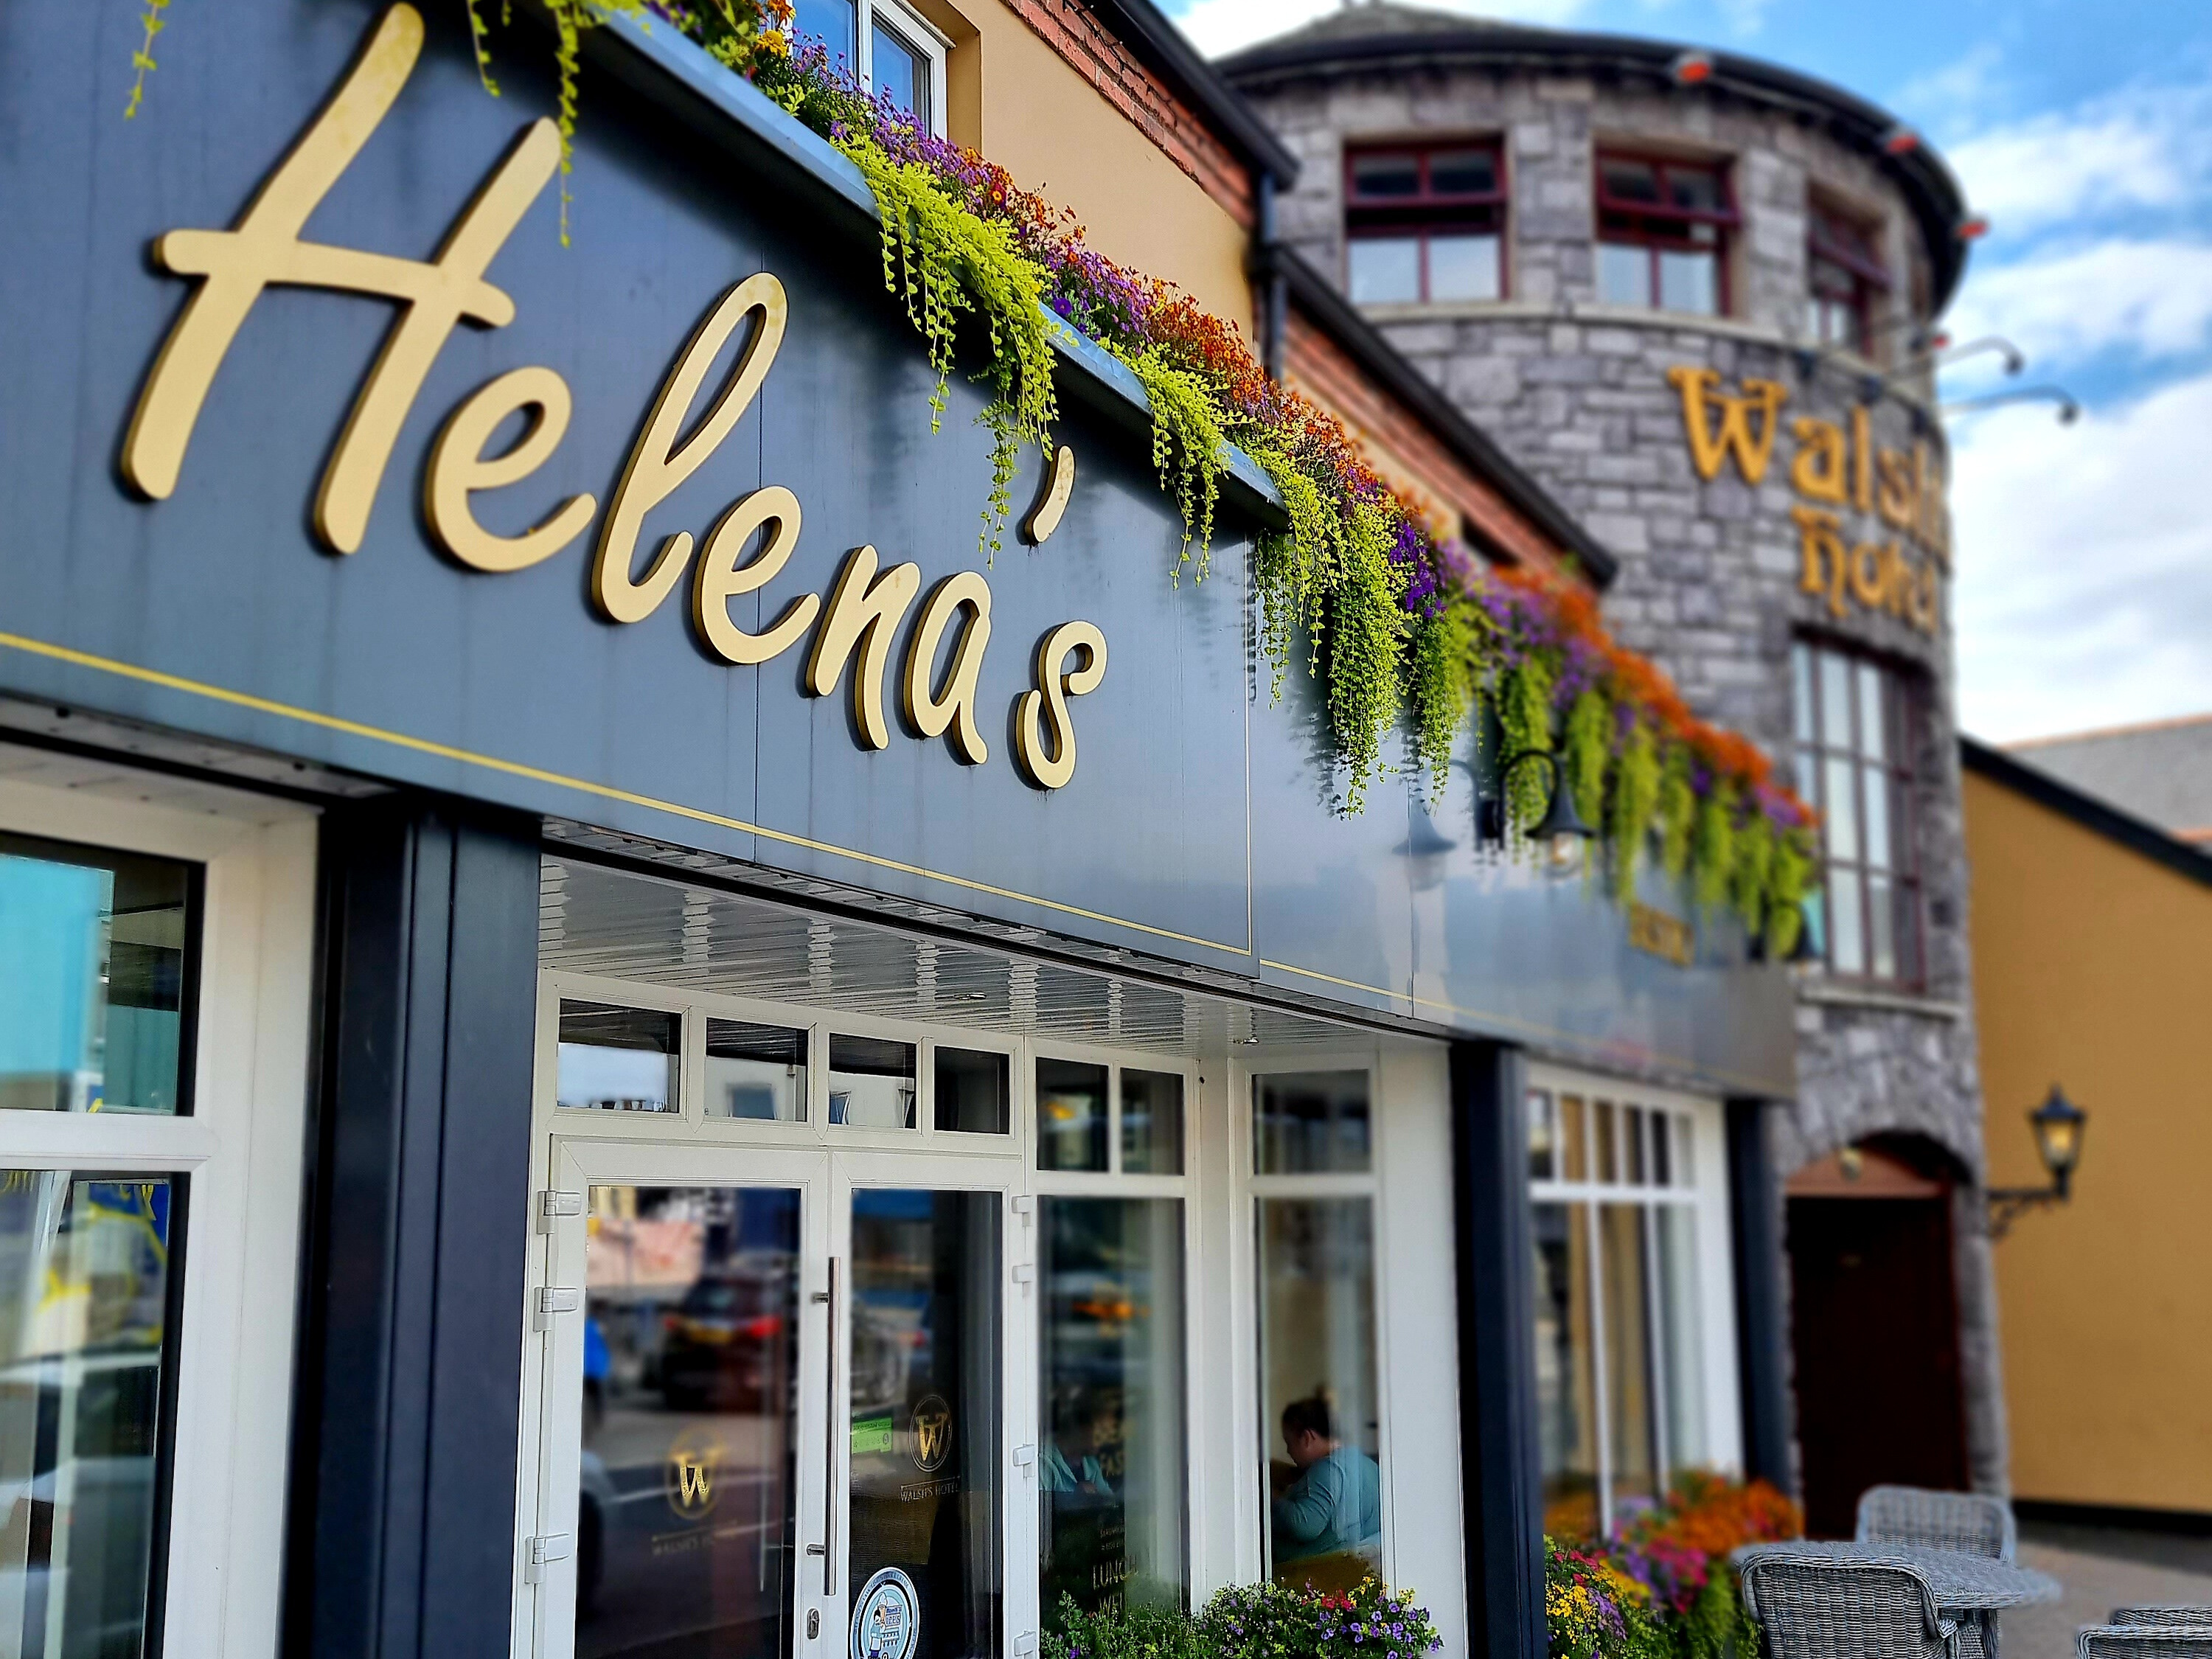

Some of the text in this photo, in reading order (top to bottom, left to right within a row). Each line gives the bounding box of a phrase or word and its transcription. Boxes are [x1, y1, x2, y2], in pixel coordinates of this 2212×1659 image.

[119, 1, 1107, 789] Helena's
[916, 1413, 948, 1461] W
[669, 1447, 726, 1509] W
